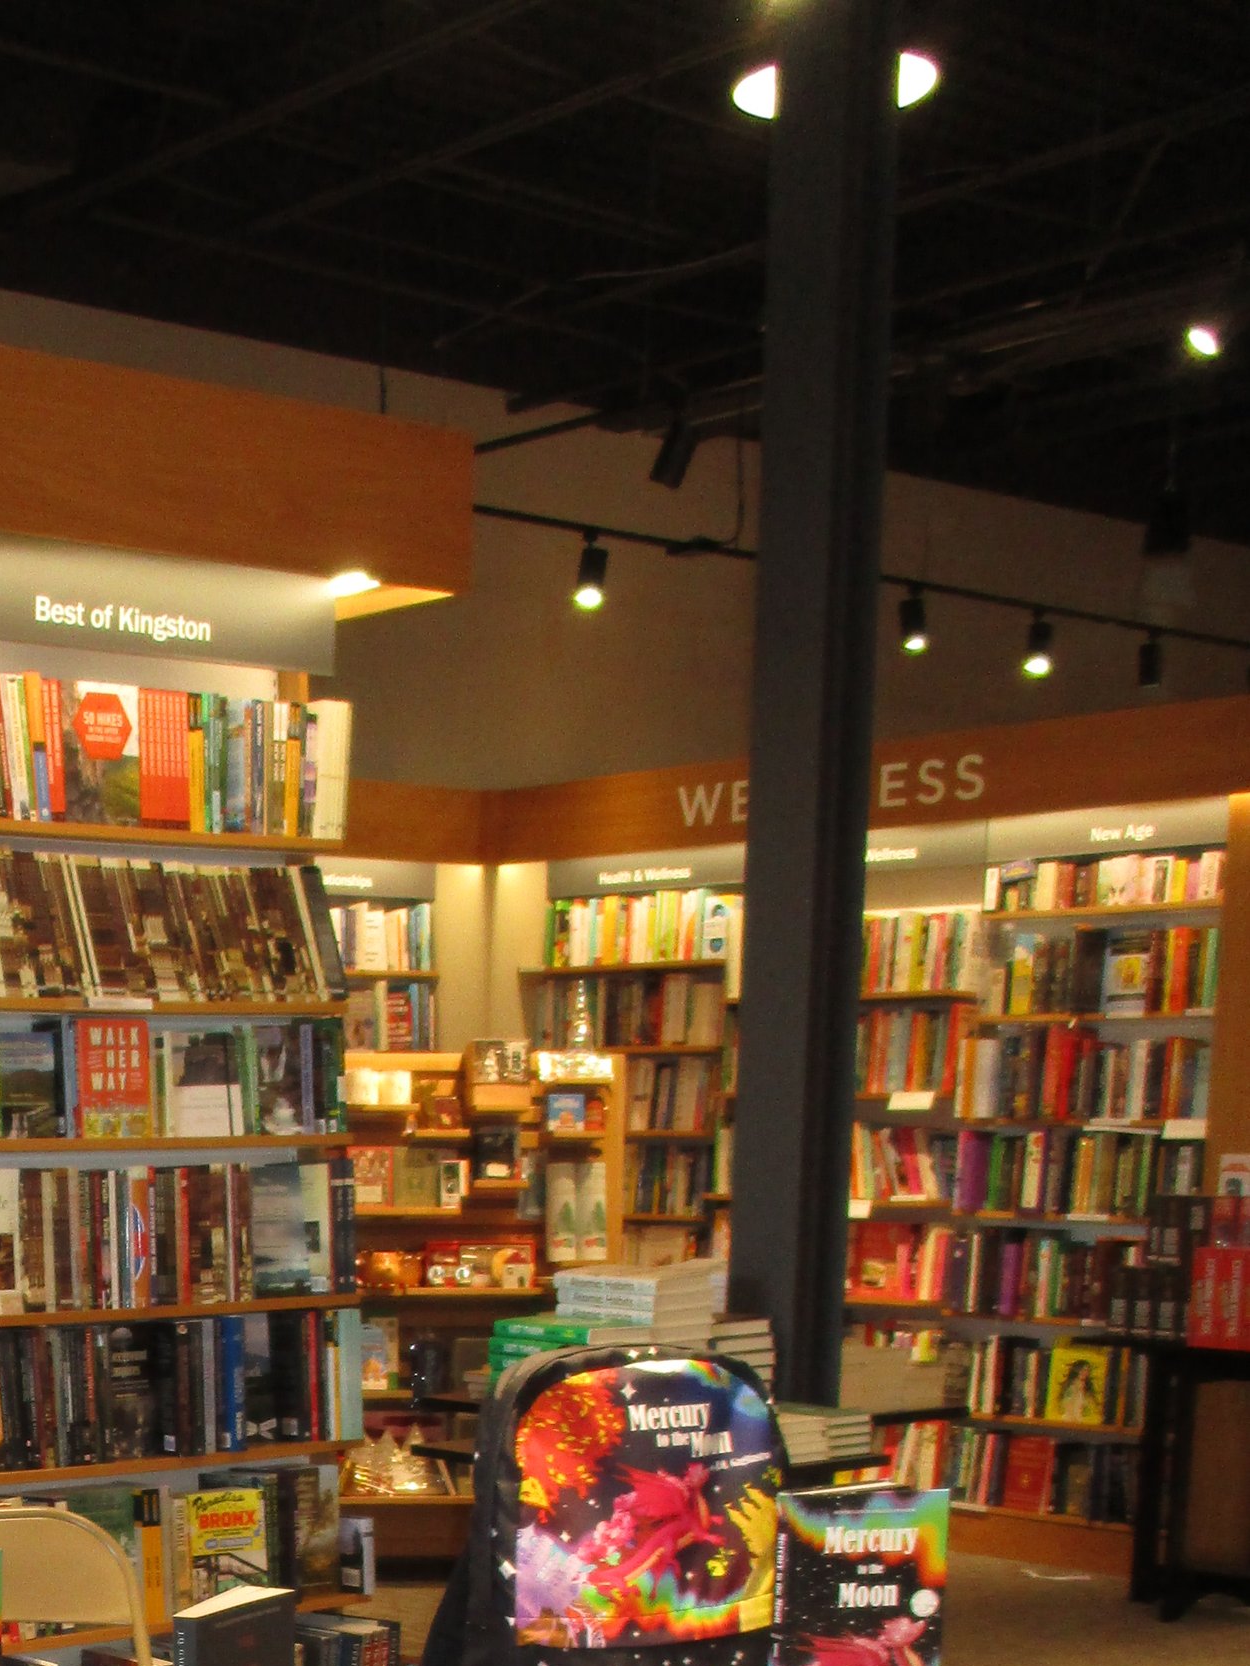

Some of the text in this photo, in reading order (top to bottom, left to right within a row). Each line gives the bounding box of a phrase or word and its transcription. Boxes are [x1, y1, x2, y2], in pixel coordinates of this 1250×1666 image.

[34, 594, 212, 643] Best of Kingston
[1090, 823, 1155, 842] New Age
[89, 1026, 140, 1046] WALK
[106, 1050, 140, 1068] HER
[90, 1072, 127, 1091] WAY
[628, 1403, 711, 1432] Mercury
[690, 1430, 733, 1458] Moon
[198, 1510, 257, 1529] BRONX
[824, 1526, 920, 1555] Mercury
[838, 1582, 899, 1608] Moon
